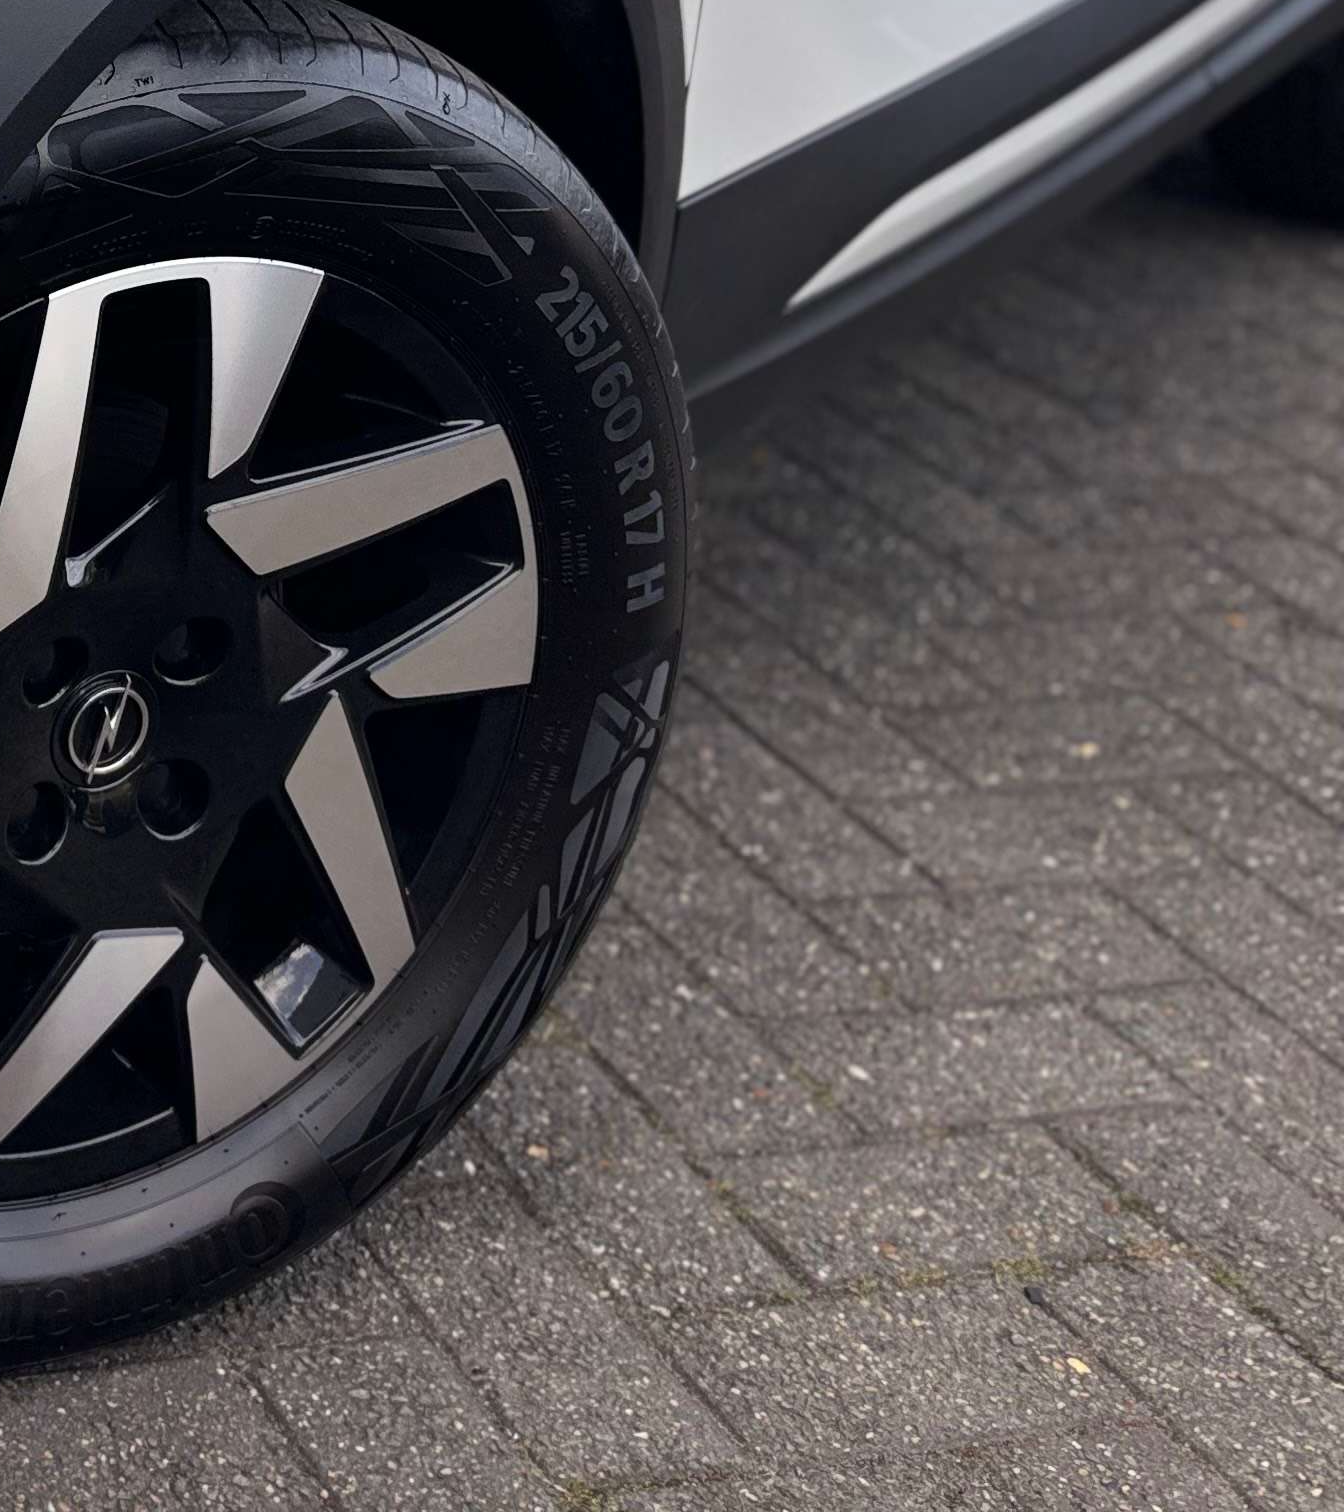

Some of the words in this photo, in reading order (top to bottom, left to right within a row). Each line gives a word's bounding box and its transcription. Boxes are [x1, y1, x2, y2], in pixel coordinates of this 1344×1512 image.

[134, 76, 154, 87] TWI
[535, 265, 644, 443] 215/60
[626, 562, 665, 613] H
